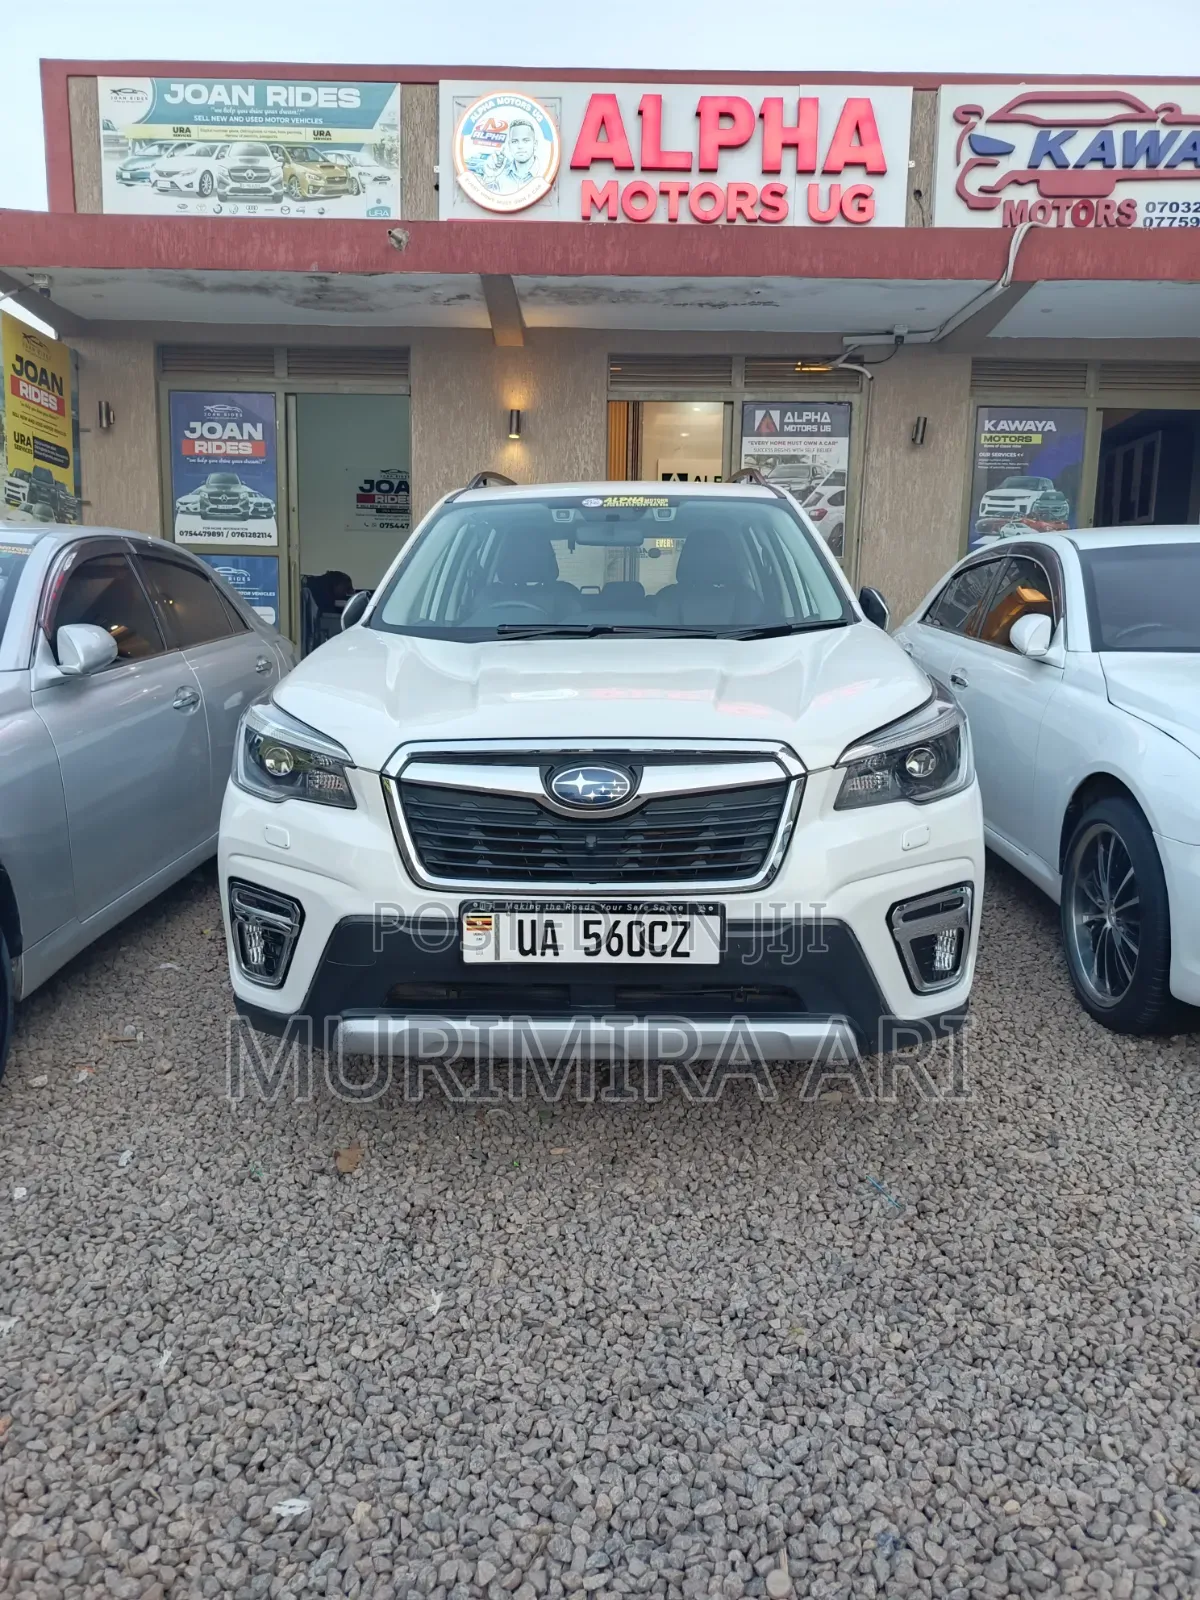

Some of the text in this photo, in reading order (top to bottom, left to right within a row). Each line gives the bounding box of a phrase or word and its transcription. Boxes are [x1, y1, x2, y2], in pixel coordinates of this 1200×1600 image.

[164, 83, 361, 109] JOAN RIDES
[470, 100, 496, 123] ALPHA
[496, 97, 532, 111] MOTORS
[473, 132, 506, 141] ALPHA
[569, 93, 888, 175] ALPHA
[581, 180, 876, 225] MOTORS UG
[368, 209, 390, 218] URA
[1002, 199, 1138, 228] MOTORS
[11, 353, 64, 397] JOAN
[20, 380, 58, 412] RIDES
[784, 412, 831, 422] ALPHA
[984, 420, 1057, 432] KAWAYA
[14, 431, 32, 448] URA
[184, 422, 263, 440] JOAN
[194, 440, 252, 454] RIDES
[374, 495, 410, 504] RIDE
[506, 903, 541, 912] Making
[653, 904, 684, 912] Space
[518, 919, 691, 958] UA 560CZ
